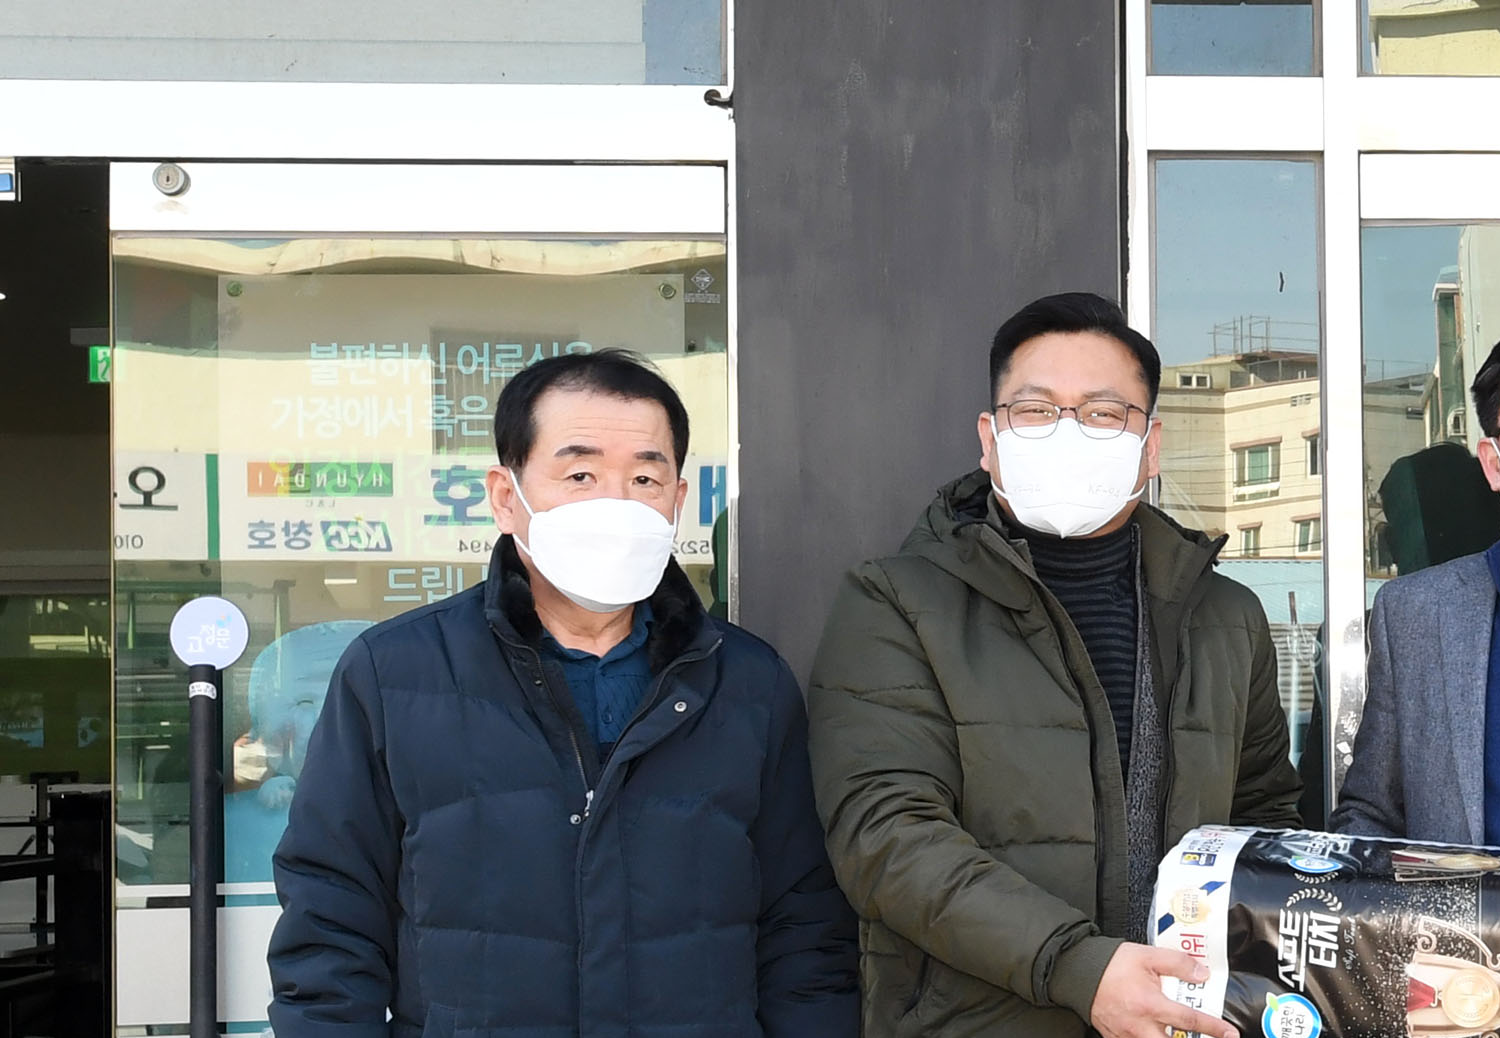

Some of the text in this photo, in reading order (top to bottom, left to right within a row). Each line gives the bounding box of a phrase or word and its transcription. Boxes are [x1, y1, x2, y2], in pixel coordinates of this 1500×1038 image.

[306, 341, 595, 385] 불편하신 어르
[271, 395, 494, 439] 가정에서 혹은
[1277, 908, 1307, 993] 소프트
[1308, 910, 1341, 969] 터치
